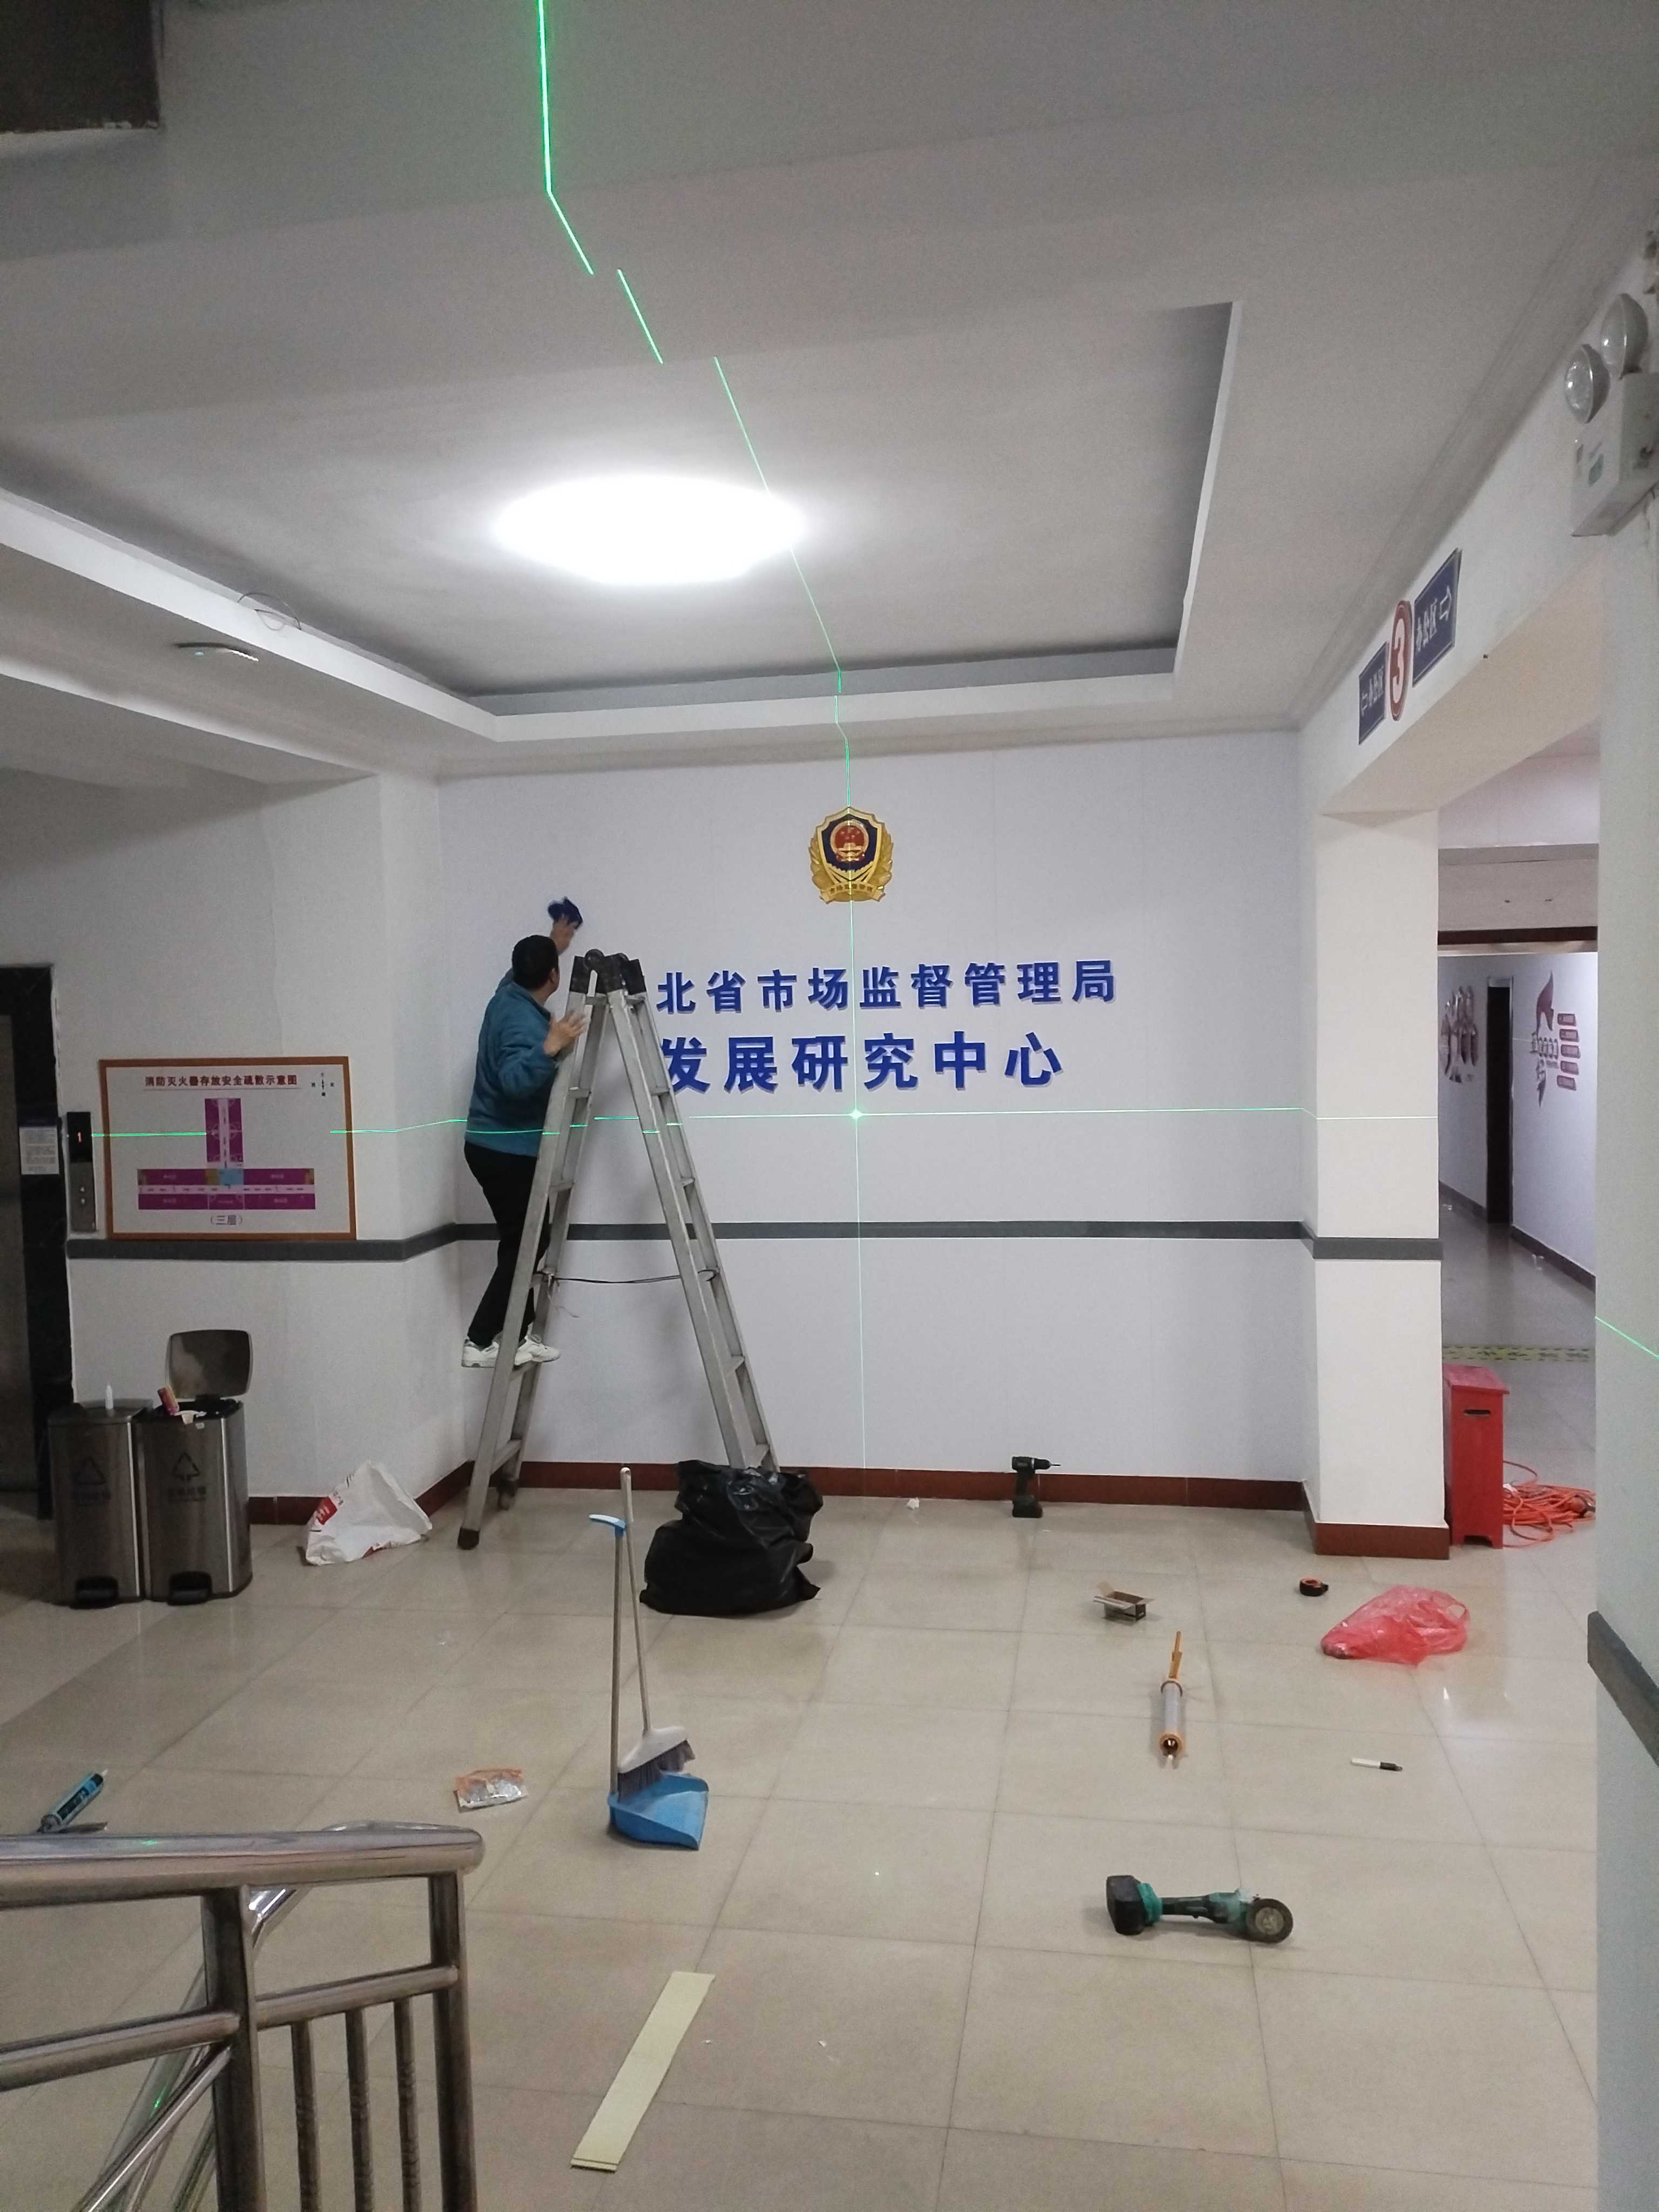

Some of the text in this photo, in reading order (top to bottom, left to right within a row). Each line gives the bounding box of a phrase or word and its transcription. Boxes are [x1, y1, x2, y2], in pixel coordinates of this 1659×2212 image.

[1393, 618, 1405, 704] 3
[656, 960, 1115, 1014] 北省市场监督管理局
[660, 1031, 1063, 1094] 发展研究中心
